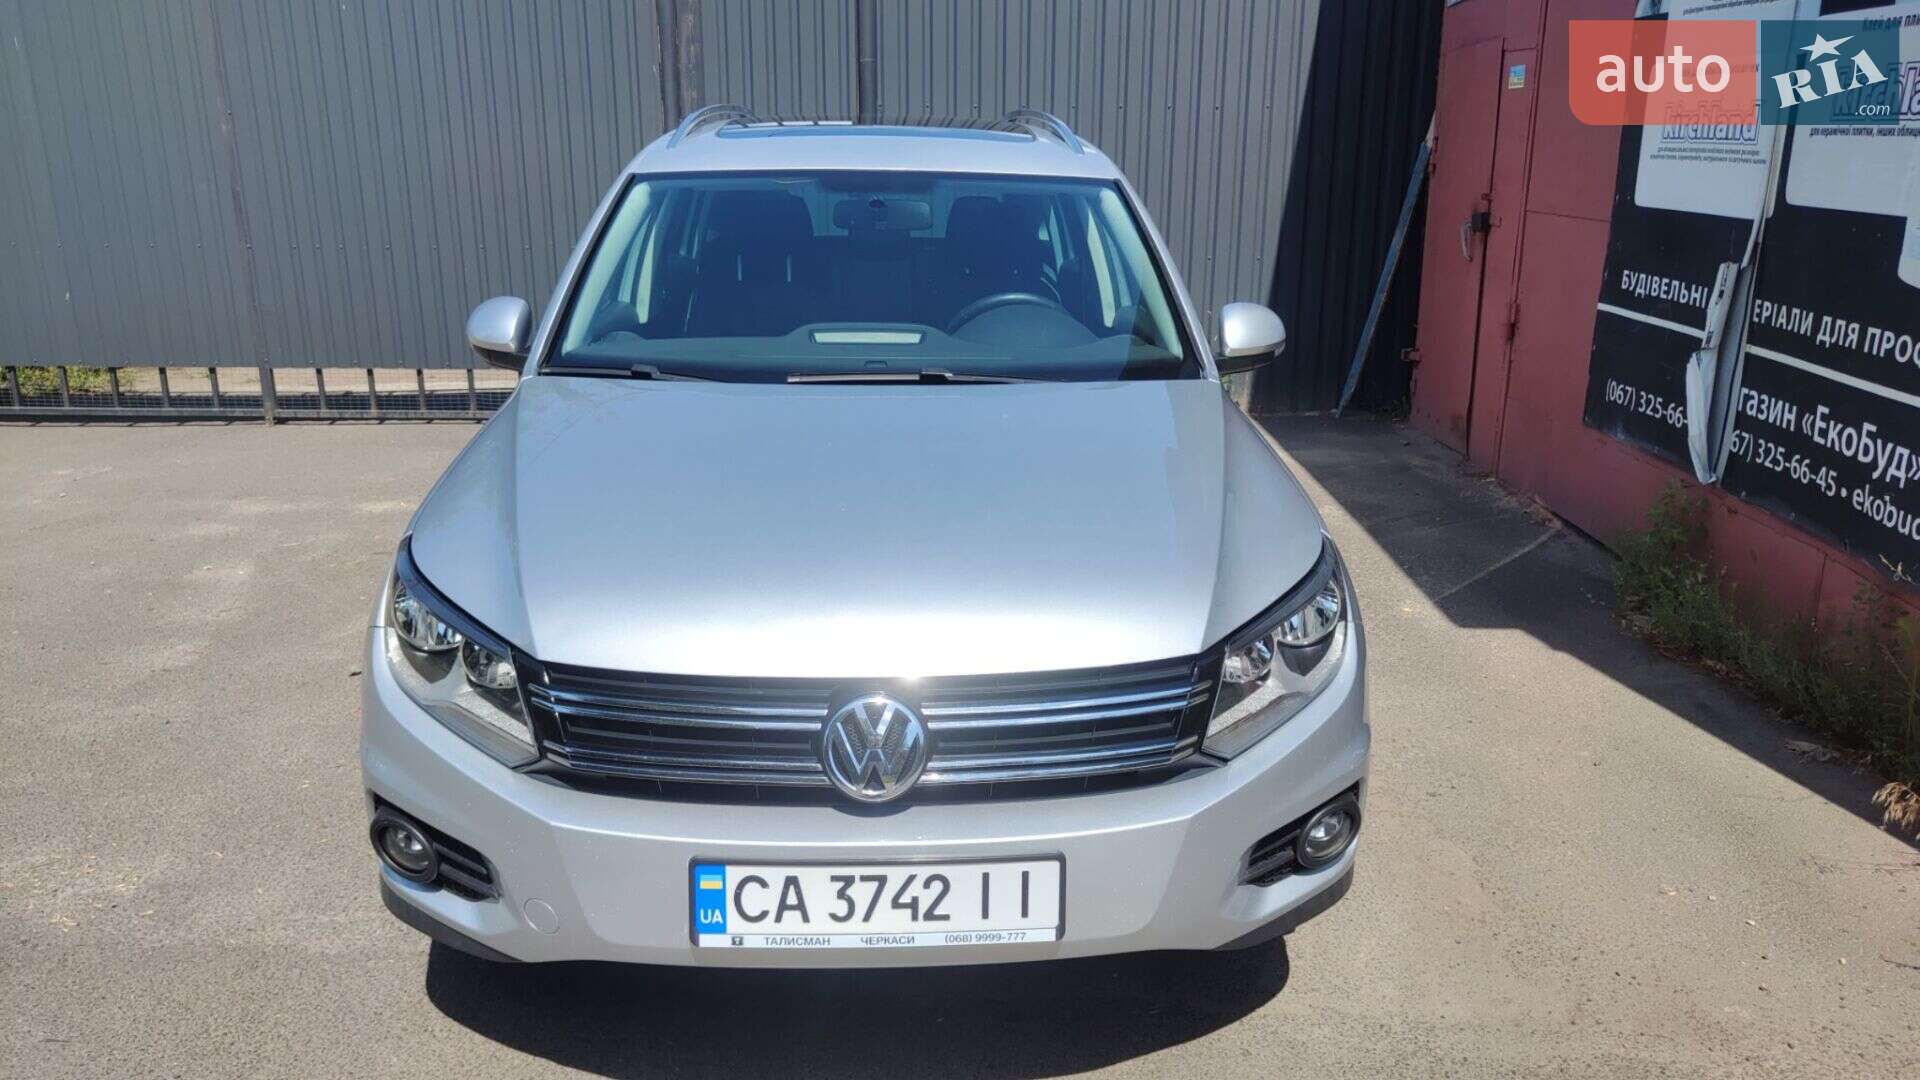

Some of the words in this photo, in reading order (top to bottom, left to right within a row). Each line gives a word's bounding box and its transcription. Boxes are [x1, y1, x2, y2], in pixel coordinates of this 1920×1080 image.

[1621, 269, 1708, 309] БУДІВЕЛЬНІ
[1752, 299, 1814, 337] ЕРІАЛИ
[1816, 315, 1860, 349] ДЛЯ
[1738, 387, 1797, 432] газин
[1606, 378, 1636, 412] (067)
[1638, 391, 1689, 428] 325-66-
[1731, 430, 1754, 463] 67)
[1755, 439, 1837, 497] 325-66-45
[700, 909, 723, 923] UA
[733, 874, 810, 923] CA
[828, 873, 951, 923] 3742
[764, 936, 831, 946] ТАЛИСМАН
[861, 935, 915, 946] ЧЕРКАСИ
[945, 933, 972, 944] (068)
[975, 932, 1026, 943] 9999-777
